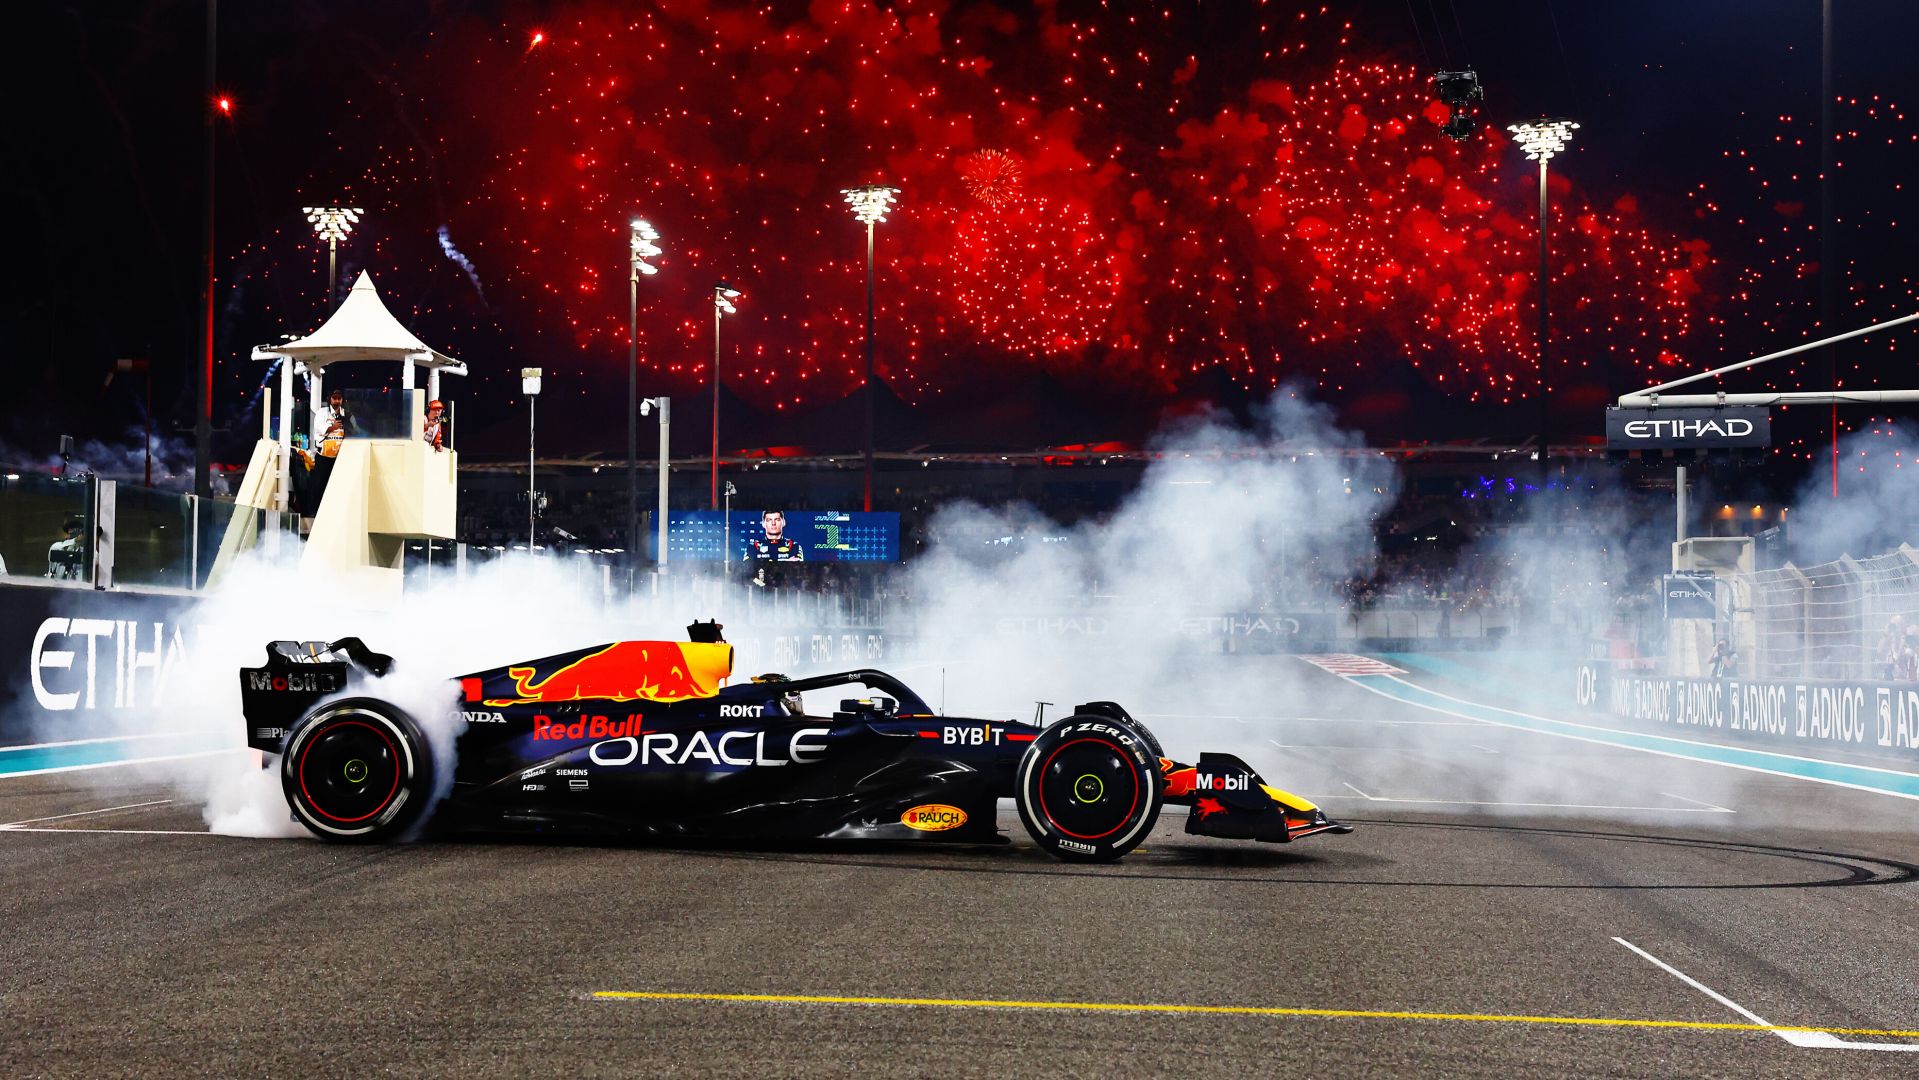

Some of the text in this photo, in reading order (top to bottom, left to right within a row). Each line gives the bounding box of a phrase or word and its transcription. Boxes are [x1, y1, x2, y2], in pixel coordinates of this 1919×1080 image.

[1624, 419, 1753, 438] ETIHAD
[996, 616, 1109, 634] ETIHAD
[1179, 616, 1299, 635] ETIHAD
[811, 634, 833, 663] ETIHAD
[31, 617, 188, 710] ETIHA
[250, 672, 318, 692] Mobil
[720, 704, 764, 718] ROKT
[1641, 680, 1670, 723] ADNOC
[1686, 682, 1723, 728] ADNOC
[1742, 684, 1787, 735] ADNOC
[447, 711, 507, 723] ONDA
[1810, 687, 1865, 743] ADNOC
[1896, 690, 1919, 749] AD
[533, 713, 644, 741] Red Bull
[943, 723, 1005, 746] BYBIT
[1060, 722, 1135, 746] P ZERO
[588, 728, 830, 767] ORACLE
[556, 768, 588, 776] SIEMENS
[1196, 773, 1249, 791] Mobil
[918, 812, 960, 823] RAUCH
[1058, 839, 1096, 855] PIRELLI
